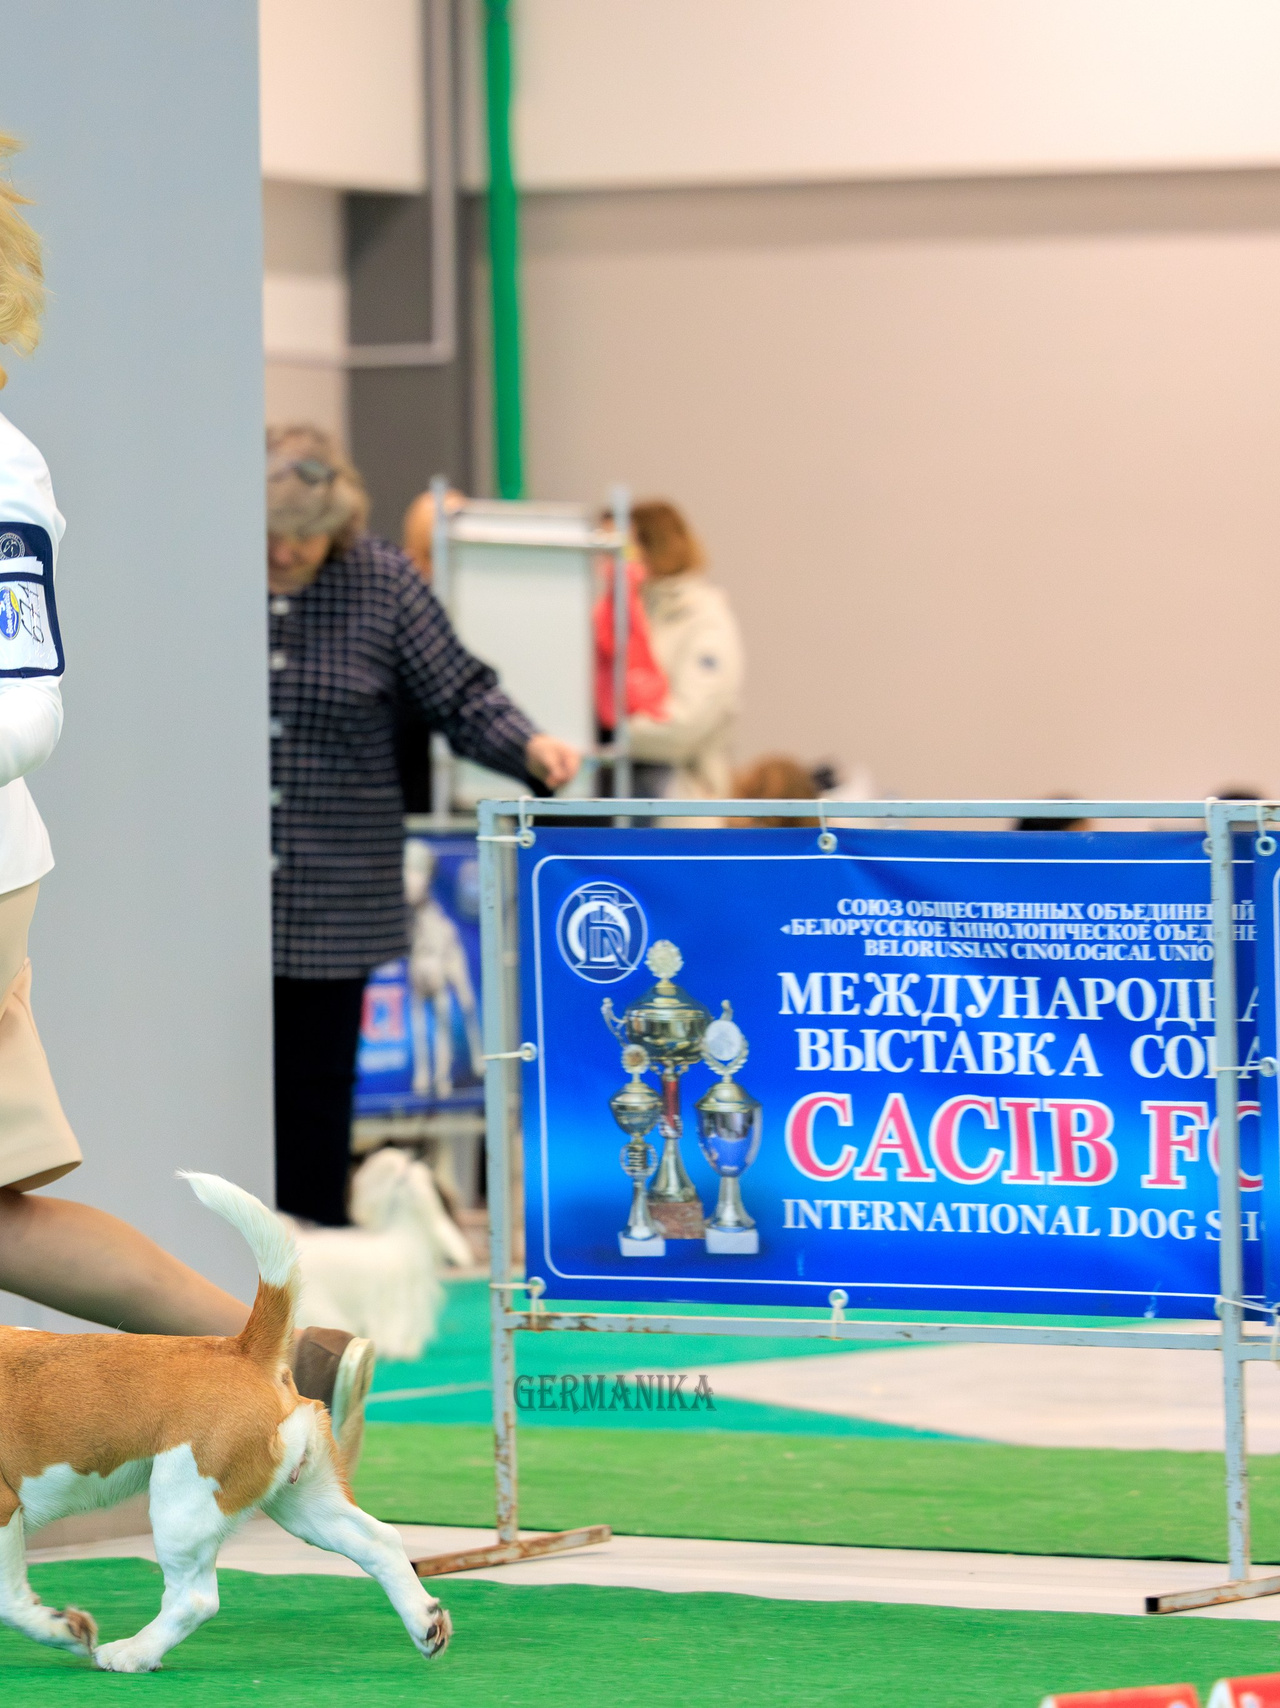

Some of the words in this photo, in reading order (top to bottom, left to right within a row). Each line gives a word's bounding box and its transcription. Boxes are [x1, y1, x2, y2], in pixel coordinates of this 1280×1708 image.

[17, 583, 45, 644] 671
[837, 898, 904, 917] СОЮЗ
[905, 900, 1084, 920] ОБЩЕСТВЕННЫХ
[1087, 900, 1256, 923] ОБЪЕДИНЕЙ
[949, 921, 1151, 941] КИНОЛОГИЧЕСКОЕ
[864, 939, 1008, 959] BELORUSSIAN
[1010, 943, 1156, 961] CINOLOGICAL
[794, 1028, 1104, 1077] ВЫСТАВКА
[784, 1091, 1119, 1187] CACIB
[782, 1198, 1101, 1237] INTERNATIONAL
[1108, 1207, 1198, 1241] DOG
